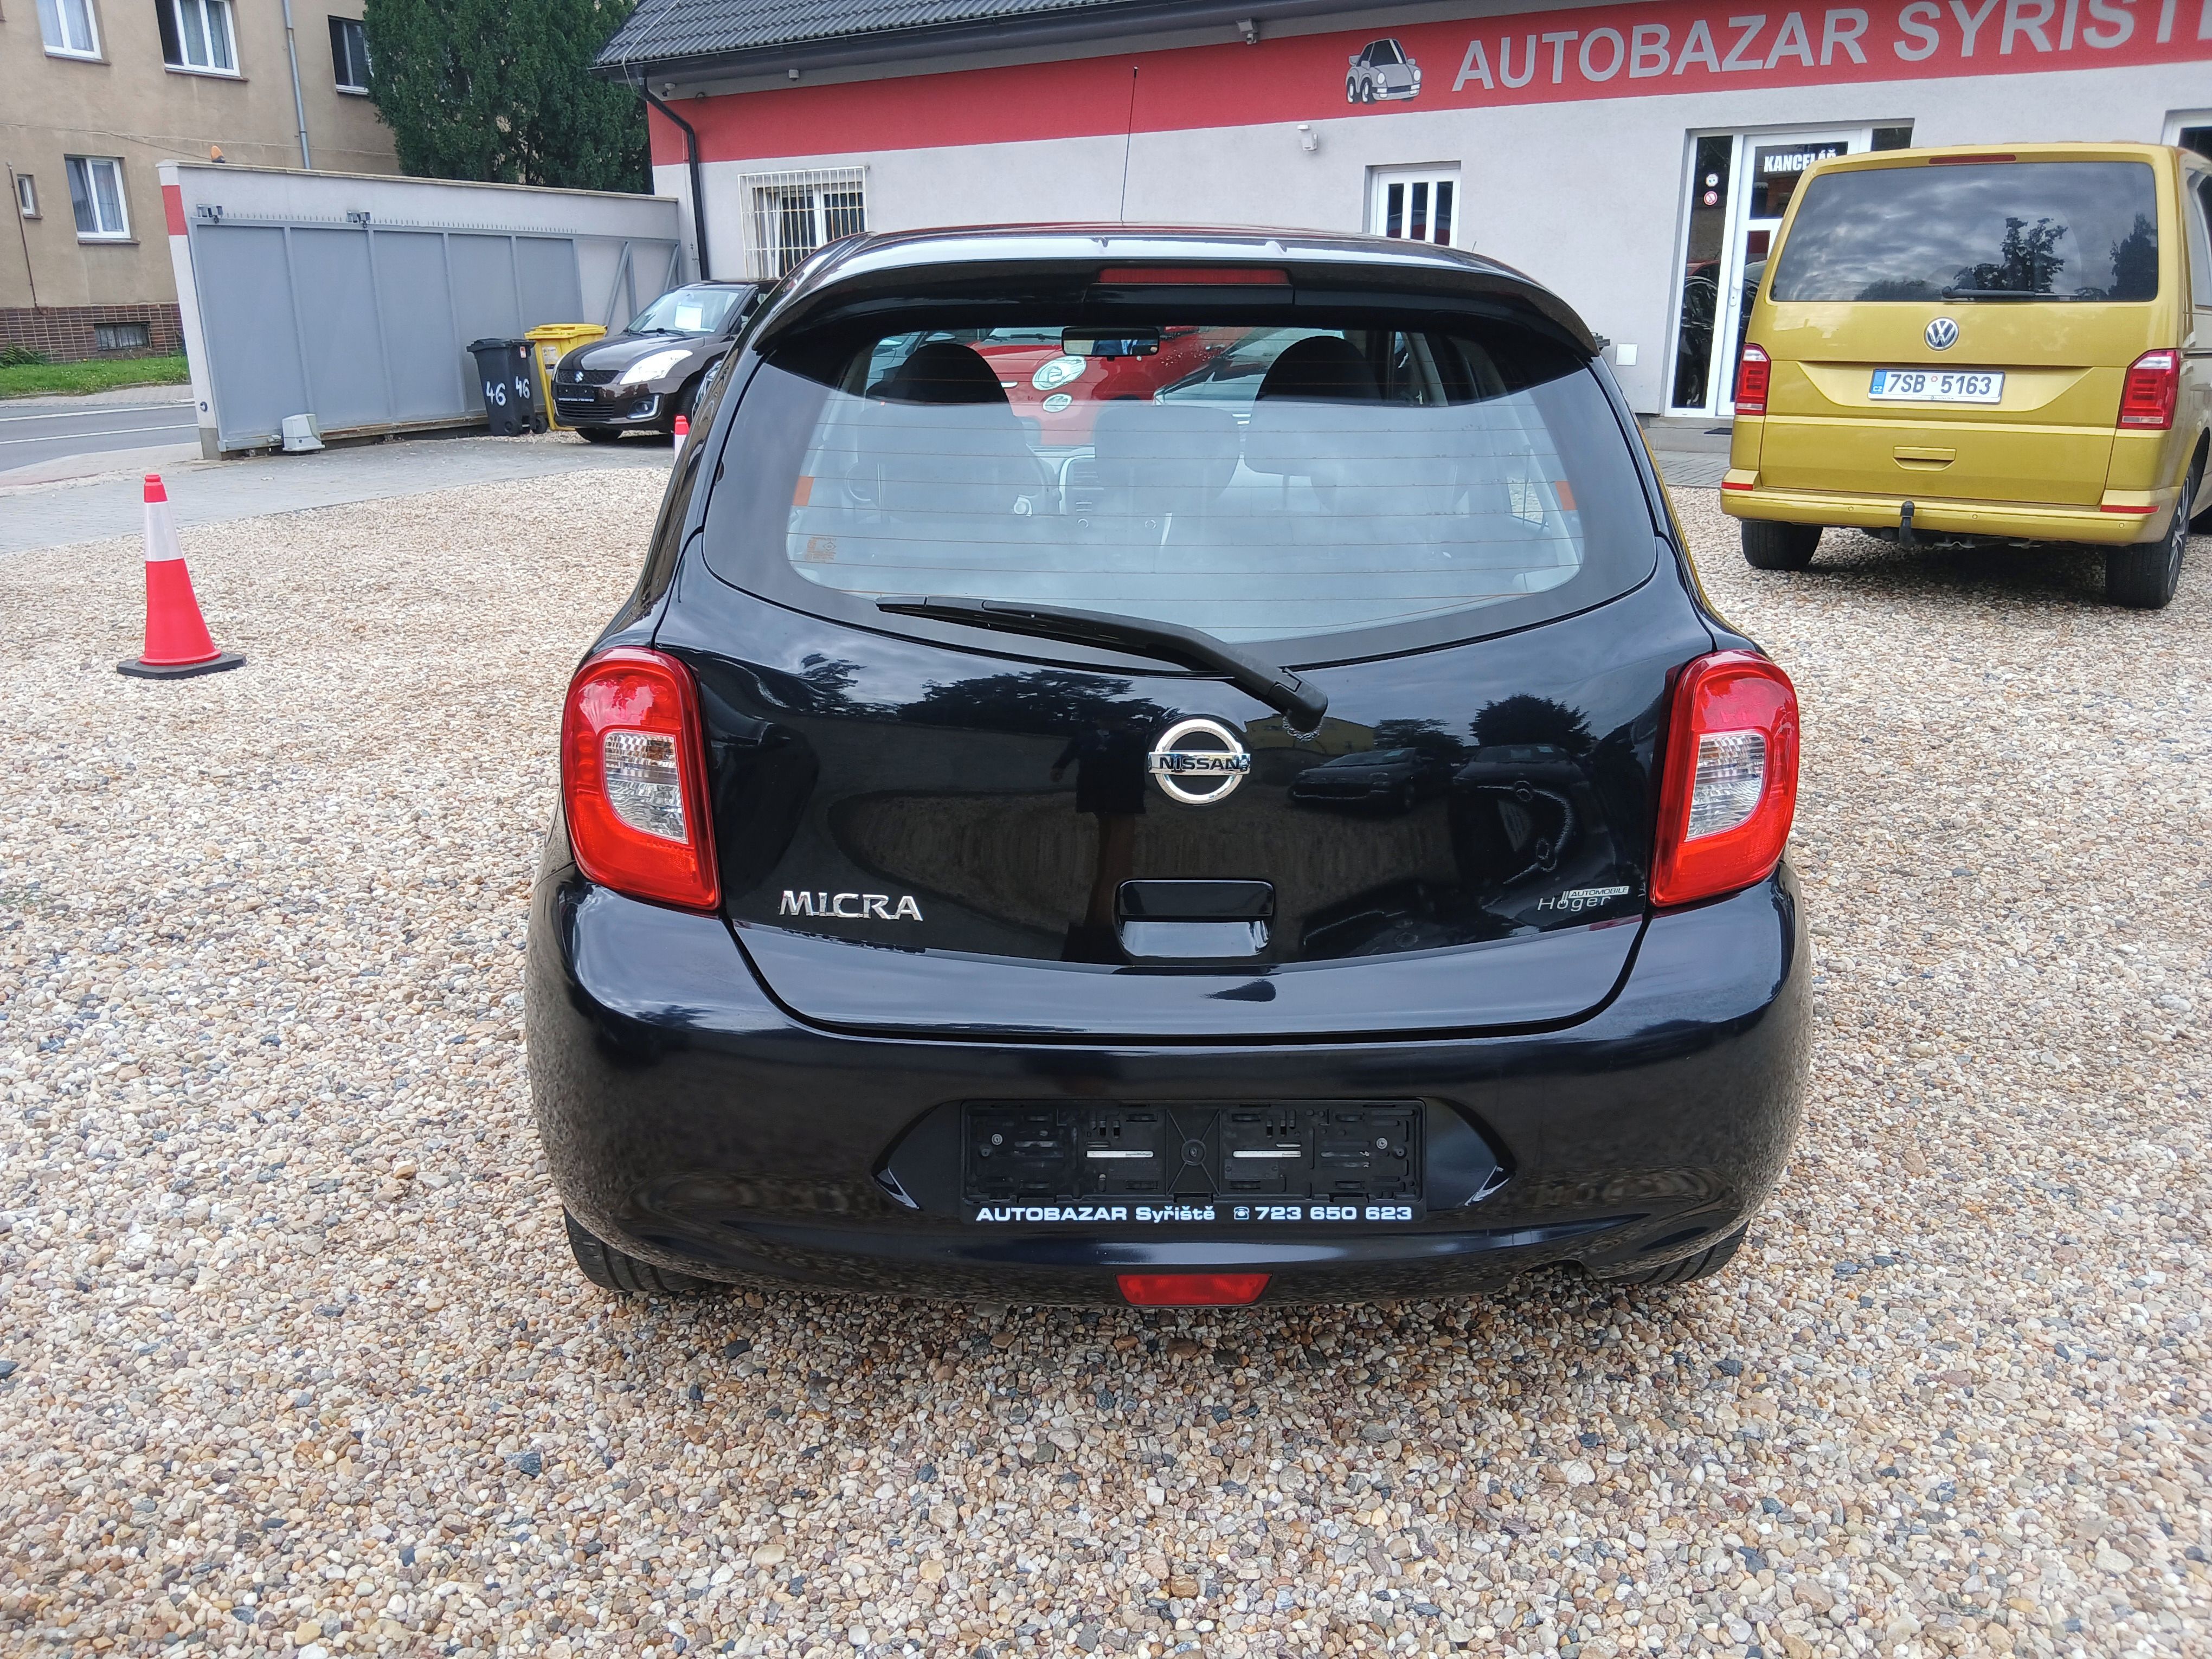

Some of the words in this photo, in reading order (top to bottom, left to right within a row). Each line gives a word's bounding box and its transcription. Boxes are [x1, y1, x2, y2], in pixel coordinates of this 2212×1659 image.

[1451, 8, 1869, 92] AUTOBAZAR
[1893, 0, 2212, 61] SYRIST
[486, 381, 507, 406] 46
[515, 376, 530, 400] 46
[1888, 374, 1926, 393] 7SB
[1940, 375, 1992, 395] 5163
[1159, 756, 1239, 770] NISSAN
[1571, 887, 1628, 898] AUTOMOBILE
[779, 890, 924, 922] MICRA
[975, 1207, 1128, 1221] AUTOBAZAR
[1135, 1205, 1216, 1224] Syřiště
[1255, 1206, 1302, 1221] 723
[1310, 1206, 1356, 1221] 650
[1365, 1206, 1412, 1221] 623
